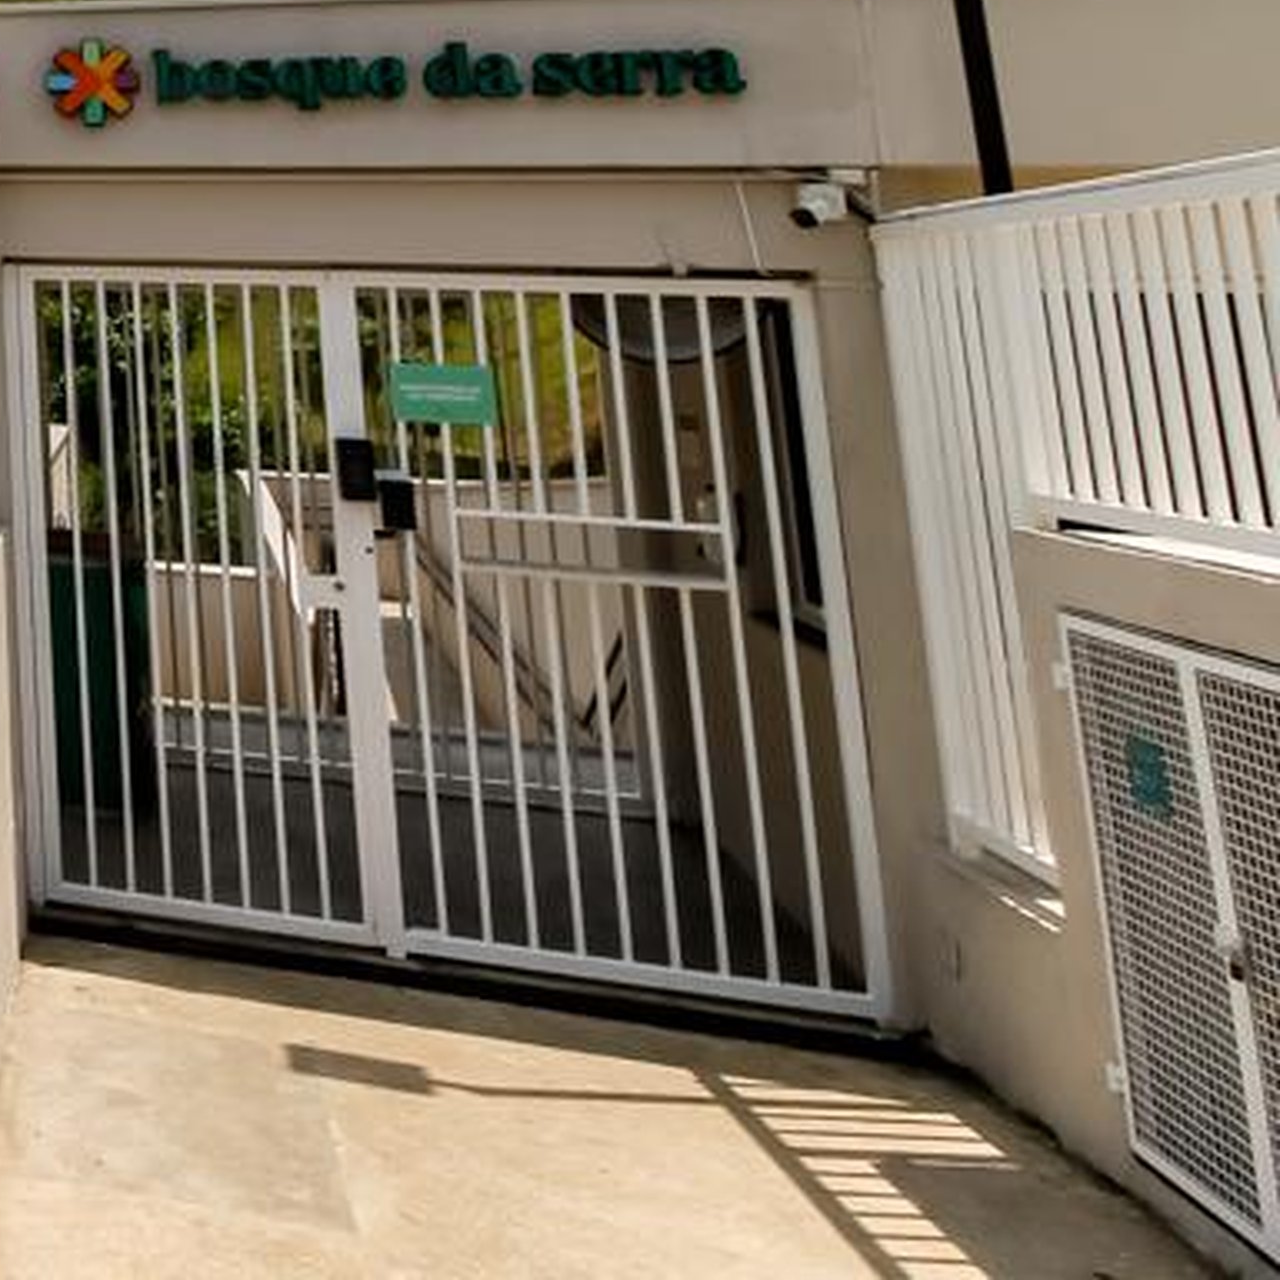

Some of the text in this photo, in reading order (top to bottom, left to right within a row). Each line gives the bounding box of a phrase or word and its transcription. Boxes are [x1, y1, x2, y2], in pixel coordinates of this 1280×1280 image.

[151, 42, 747, 110] bosque da serra
